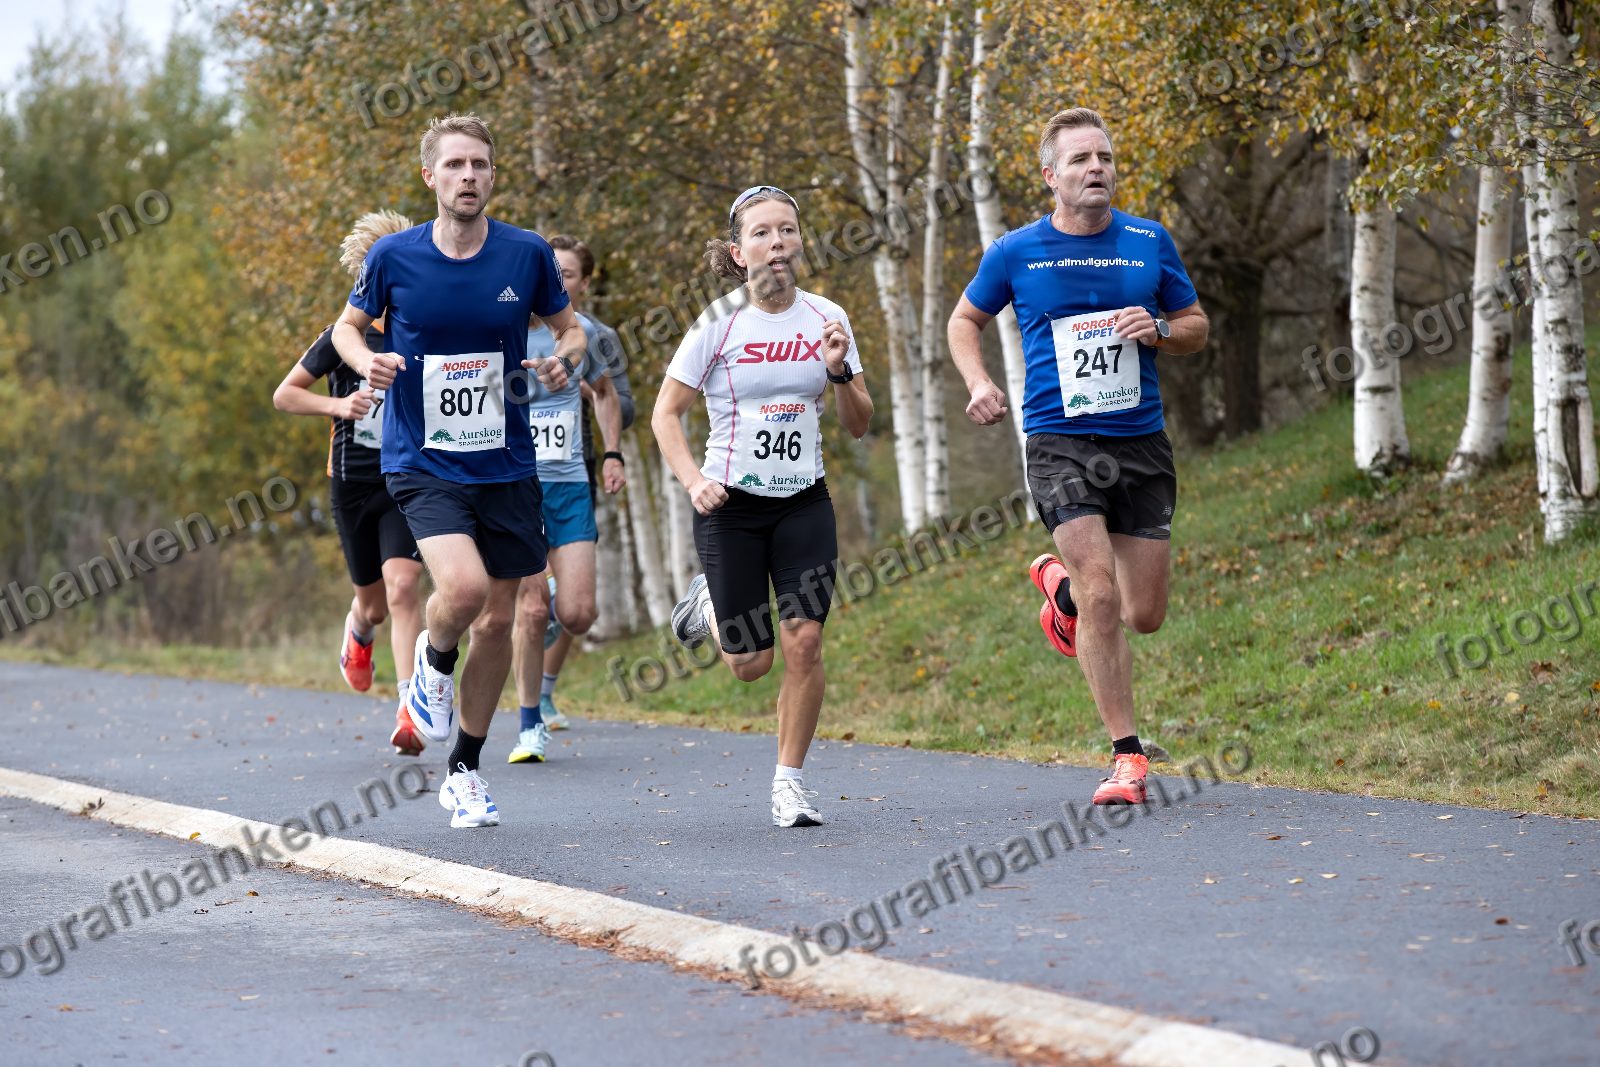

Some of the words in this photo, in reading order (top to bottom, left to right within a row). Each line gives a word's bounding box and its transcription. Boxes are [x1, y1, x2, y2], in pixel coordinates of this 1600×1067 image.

[1027, 257, 1145, 271] www.altmuliggutta.no
[1077, 327, 1115, 341] LØPET
[441, 359, 489, 372] NORGES
[1073, 343, 1122, 379] 247
[445, 369, 482, 381] LØPET
[1097, 386, 1139, 401] Aurskog
[440, 385, 489, 416] 807
[531, 410, 561, 418] LØPET
[760, 403, 806, 414] NORGES
[765, 412, 800, 423] LØPET
[458, 427, 502, 440] Aurskog
[530, 424, 566, 448] 219
[753, 429, 802, 461] 346
[768, 475, 812, 488] Aurskog
